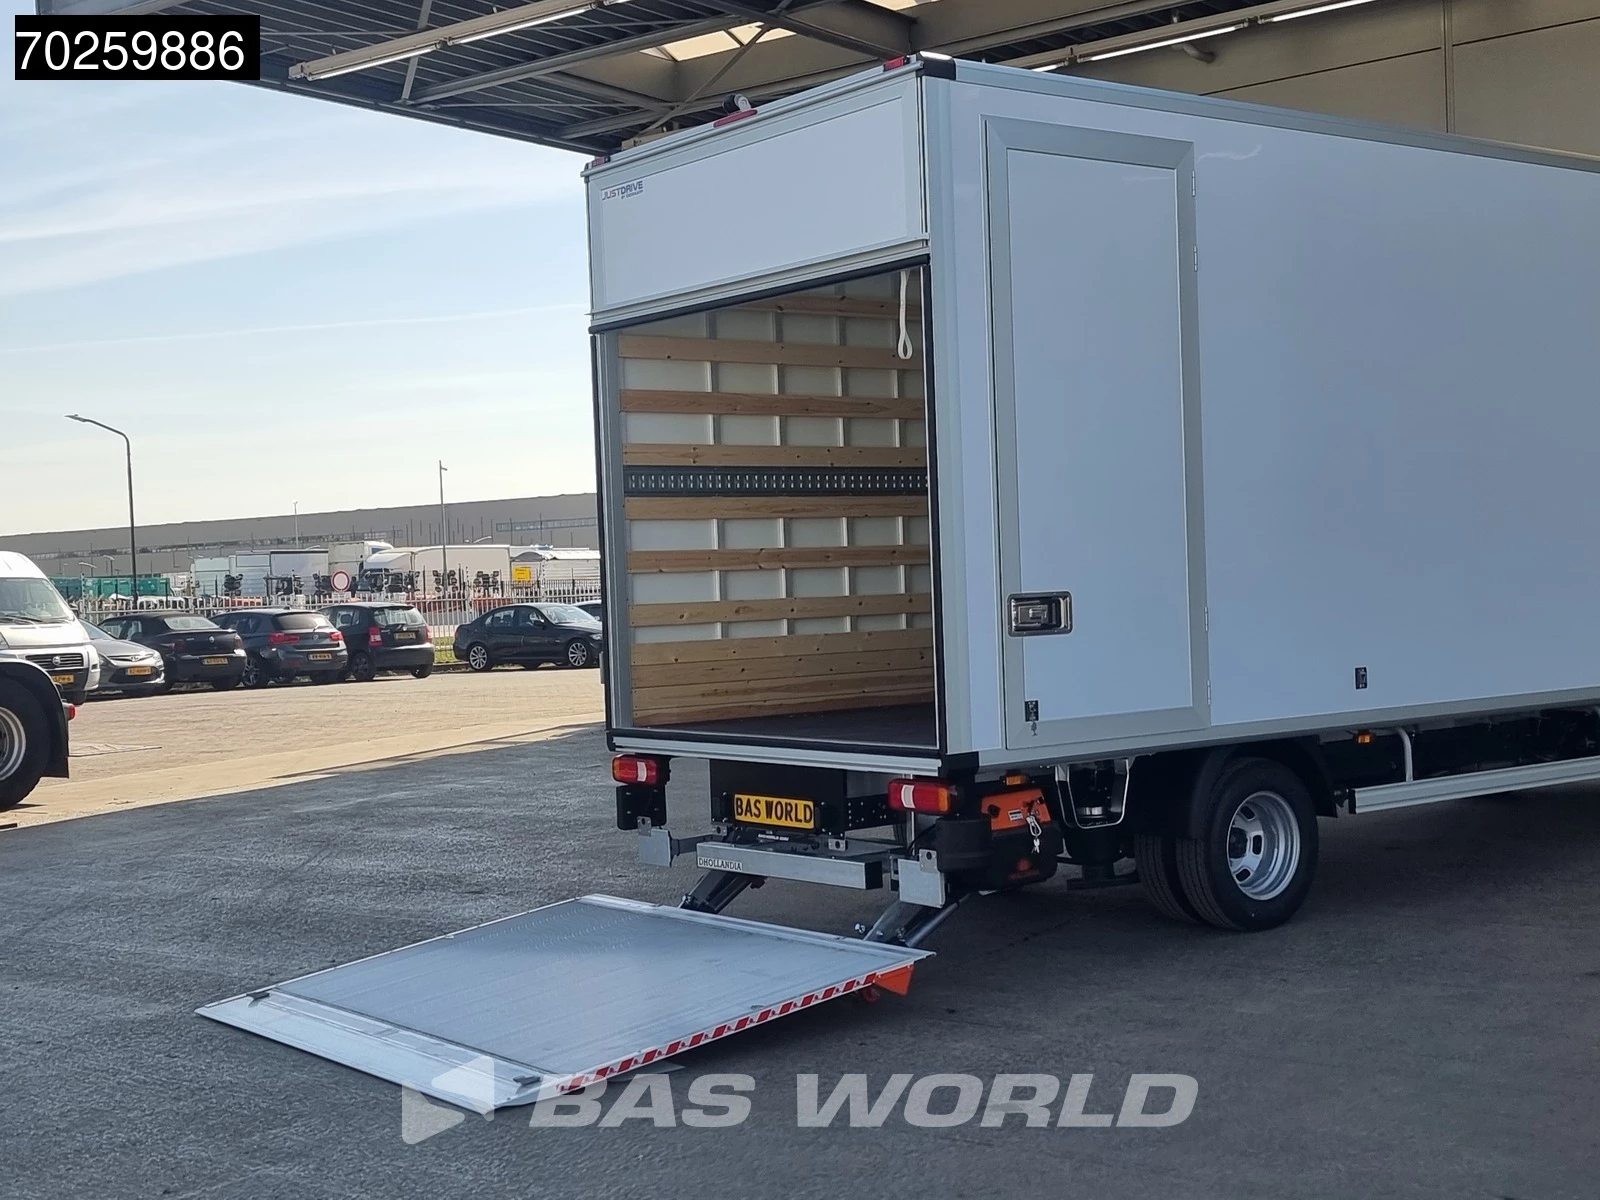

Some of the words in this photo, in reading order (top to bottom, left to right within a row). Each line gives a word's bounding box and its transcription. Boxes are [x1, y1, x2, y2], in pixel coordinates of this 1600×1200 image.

[602, 180, 643, 200] JUSTDRIVE
[735, 797, 761, 818] BAS
[765, 800, 812, 823] WORLD
[698, 857, 742, 871] DHOLLANDIA
